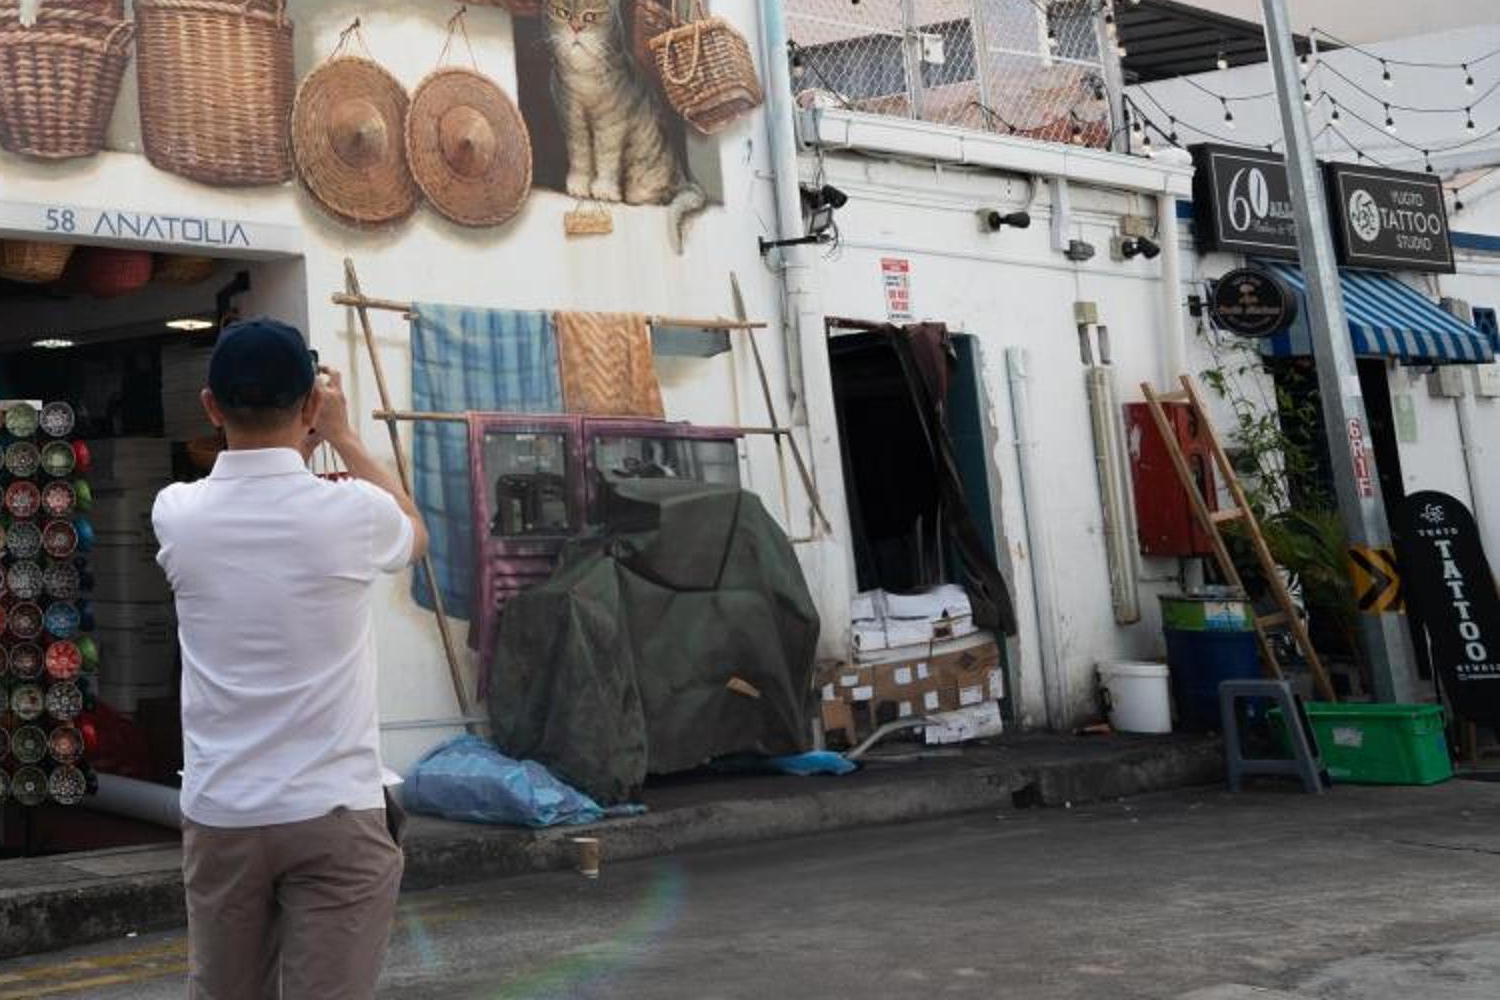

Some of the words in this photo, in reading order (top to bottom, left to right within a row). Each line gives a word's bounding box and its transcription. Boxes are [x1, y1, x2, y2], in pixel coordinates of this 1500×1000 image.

[46, 208, 76, 233] 58
[93, 211, 250, 246] ANATOLIA
[1379, 207, 1441, 235] TATTOO
[1434, 539, 1487, 661] TATTOO
